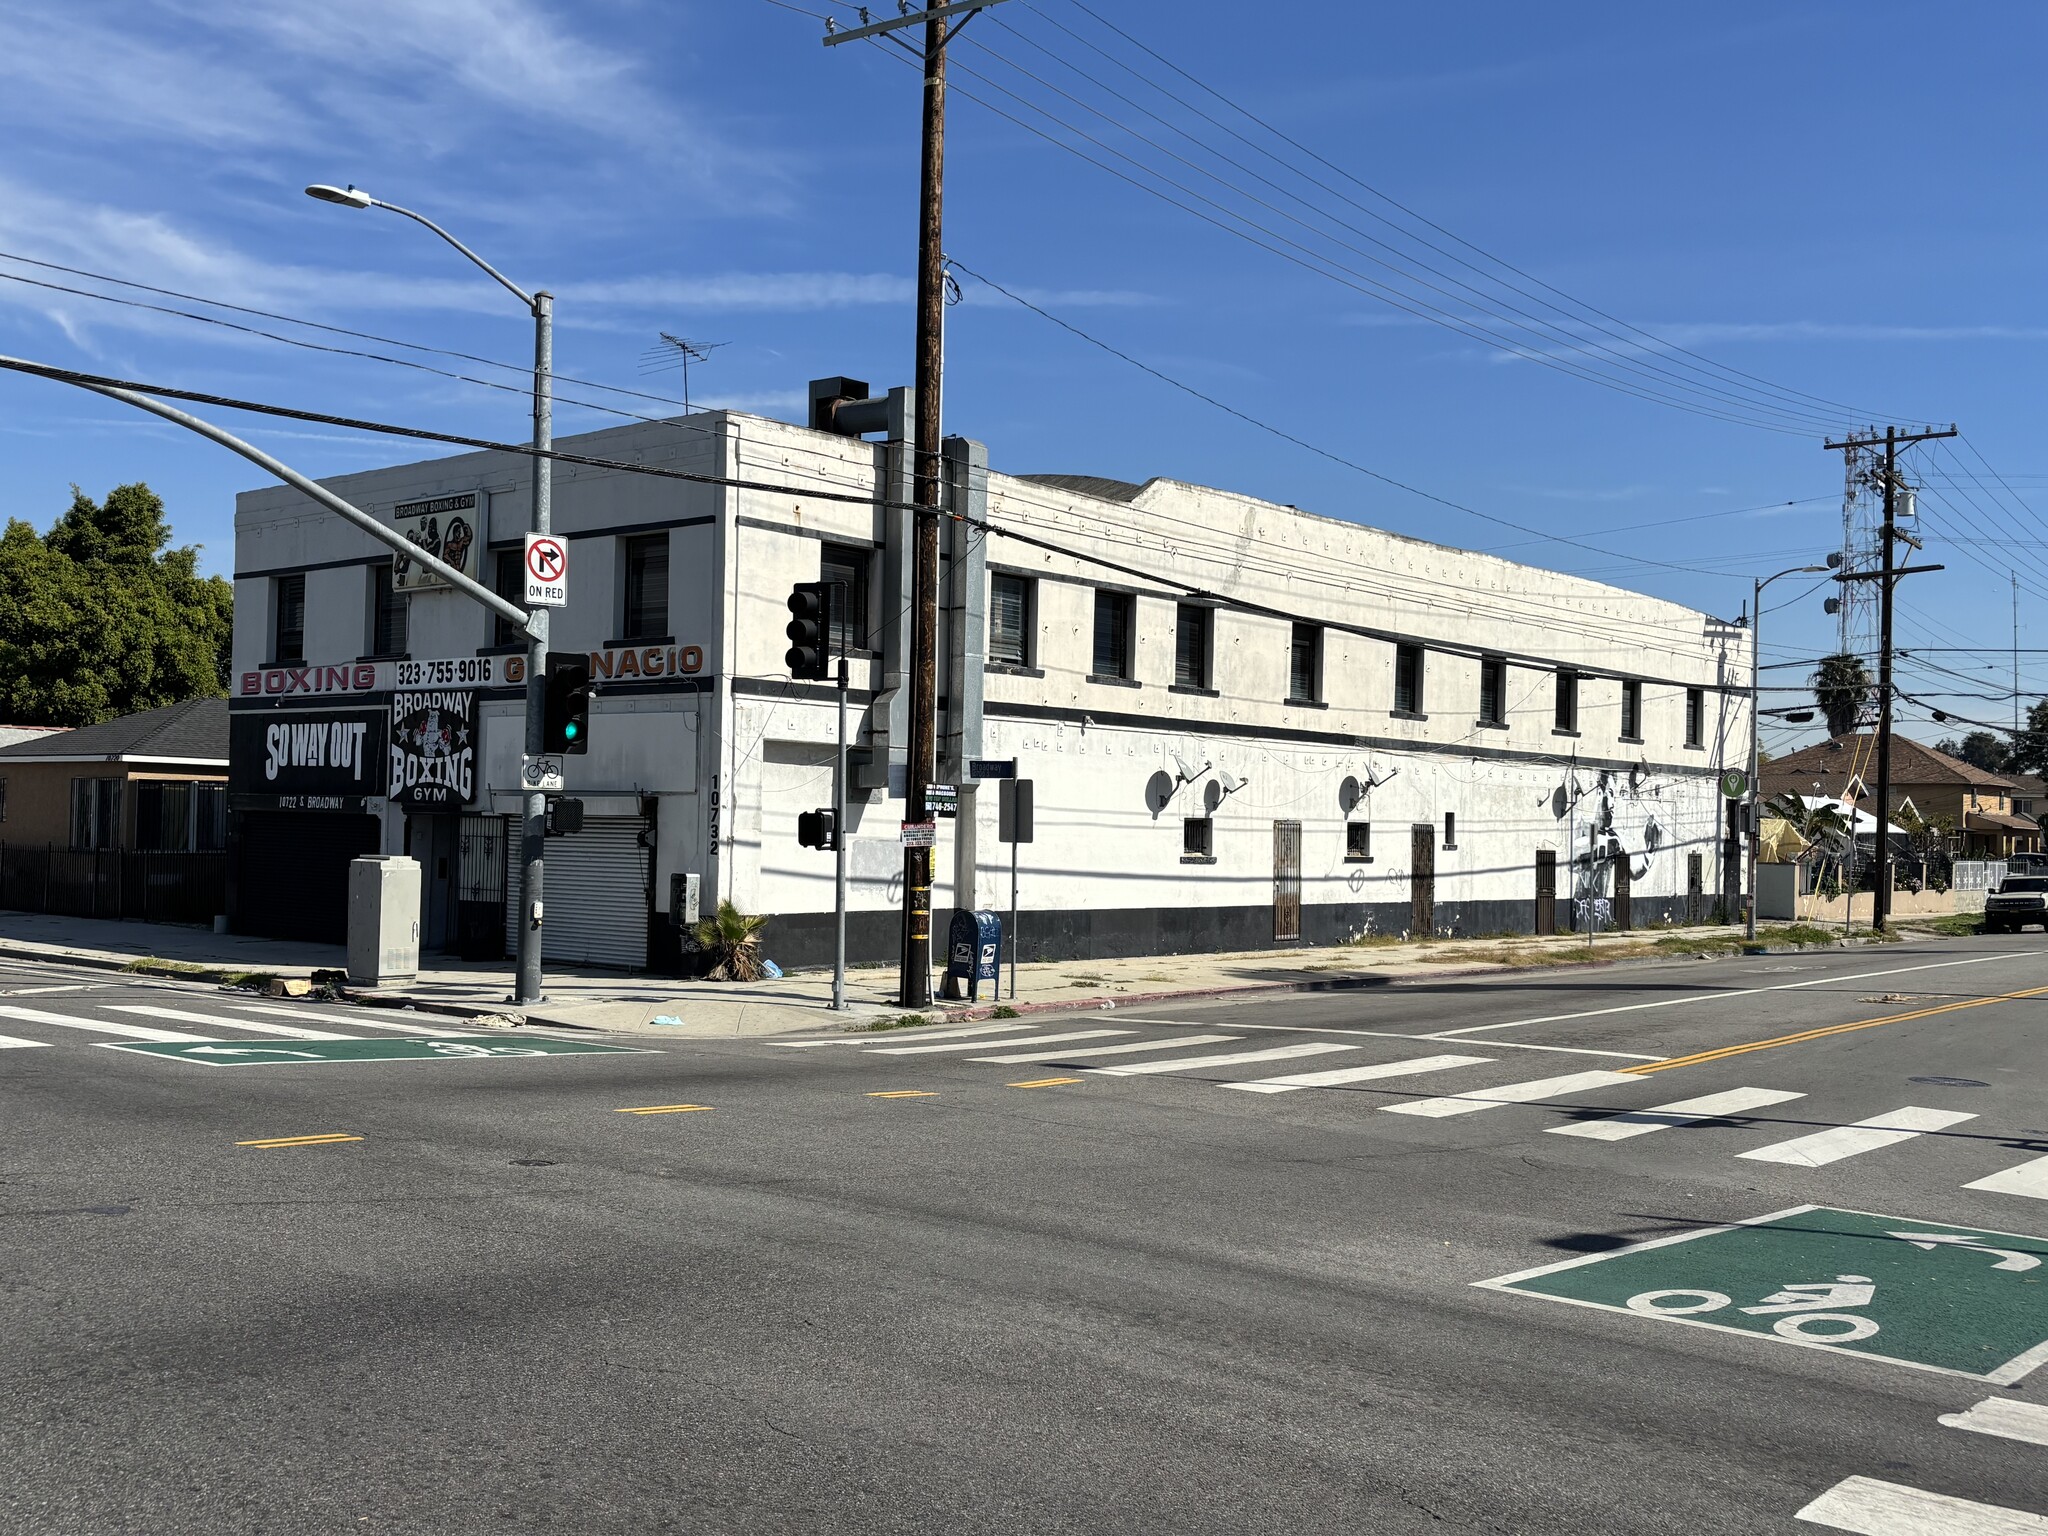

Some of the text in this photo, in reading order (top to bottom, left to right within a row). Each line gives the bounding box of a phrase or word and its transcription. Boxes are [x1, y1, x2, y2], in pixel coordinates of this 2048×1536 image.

[396, 495, 474, 517] BROADWAY BOXING & GYM
[529, 585, 563, 599] ON RED
[241, 665, 375, 695] BOXING
[394, 692, 473, 726] BROADWAY
[265, 721, 367, 780] SO WAY OUT
[390, 743, 473, 801] BOXING
[971, 762, 1002, 773] Broadway
[279, 796, 297, 809] 10722
[307, 796, 344, 809] BROADWAY
[413, 787, 447, 801] GYM
[710, 775, 719, 855] 10732
